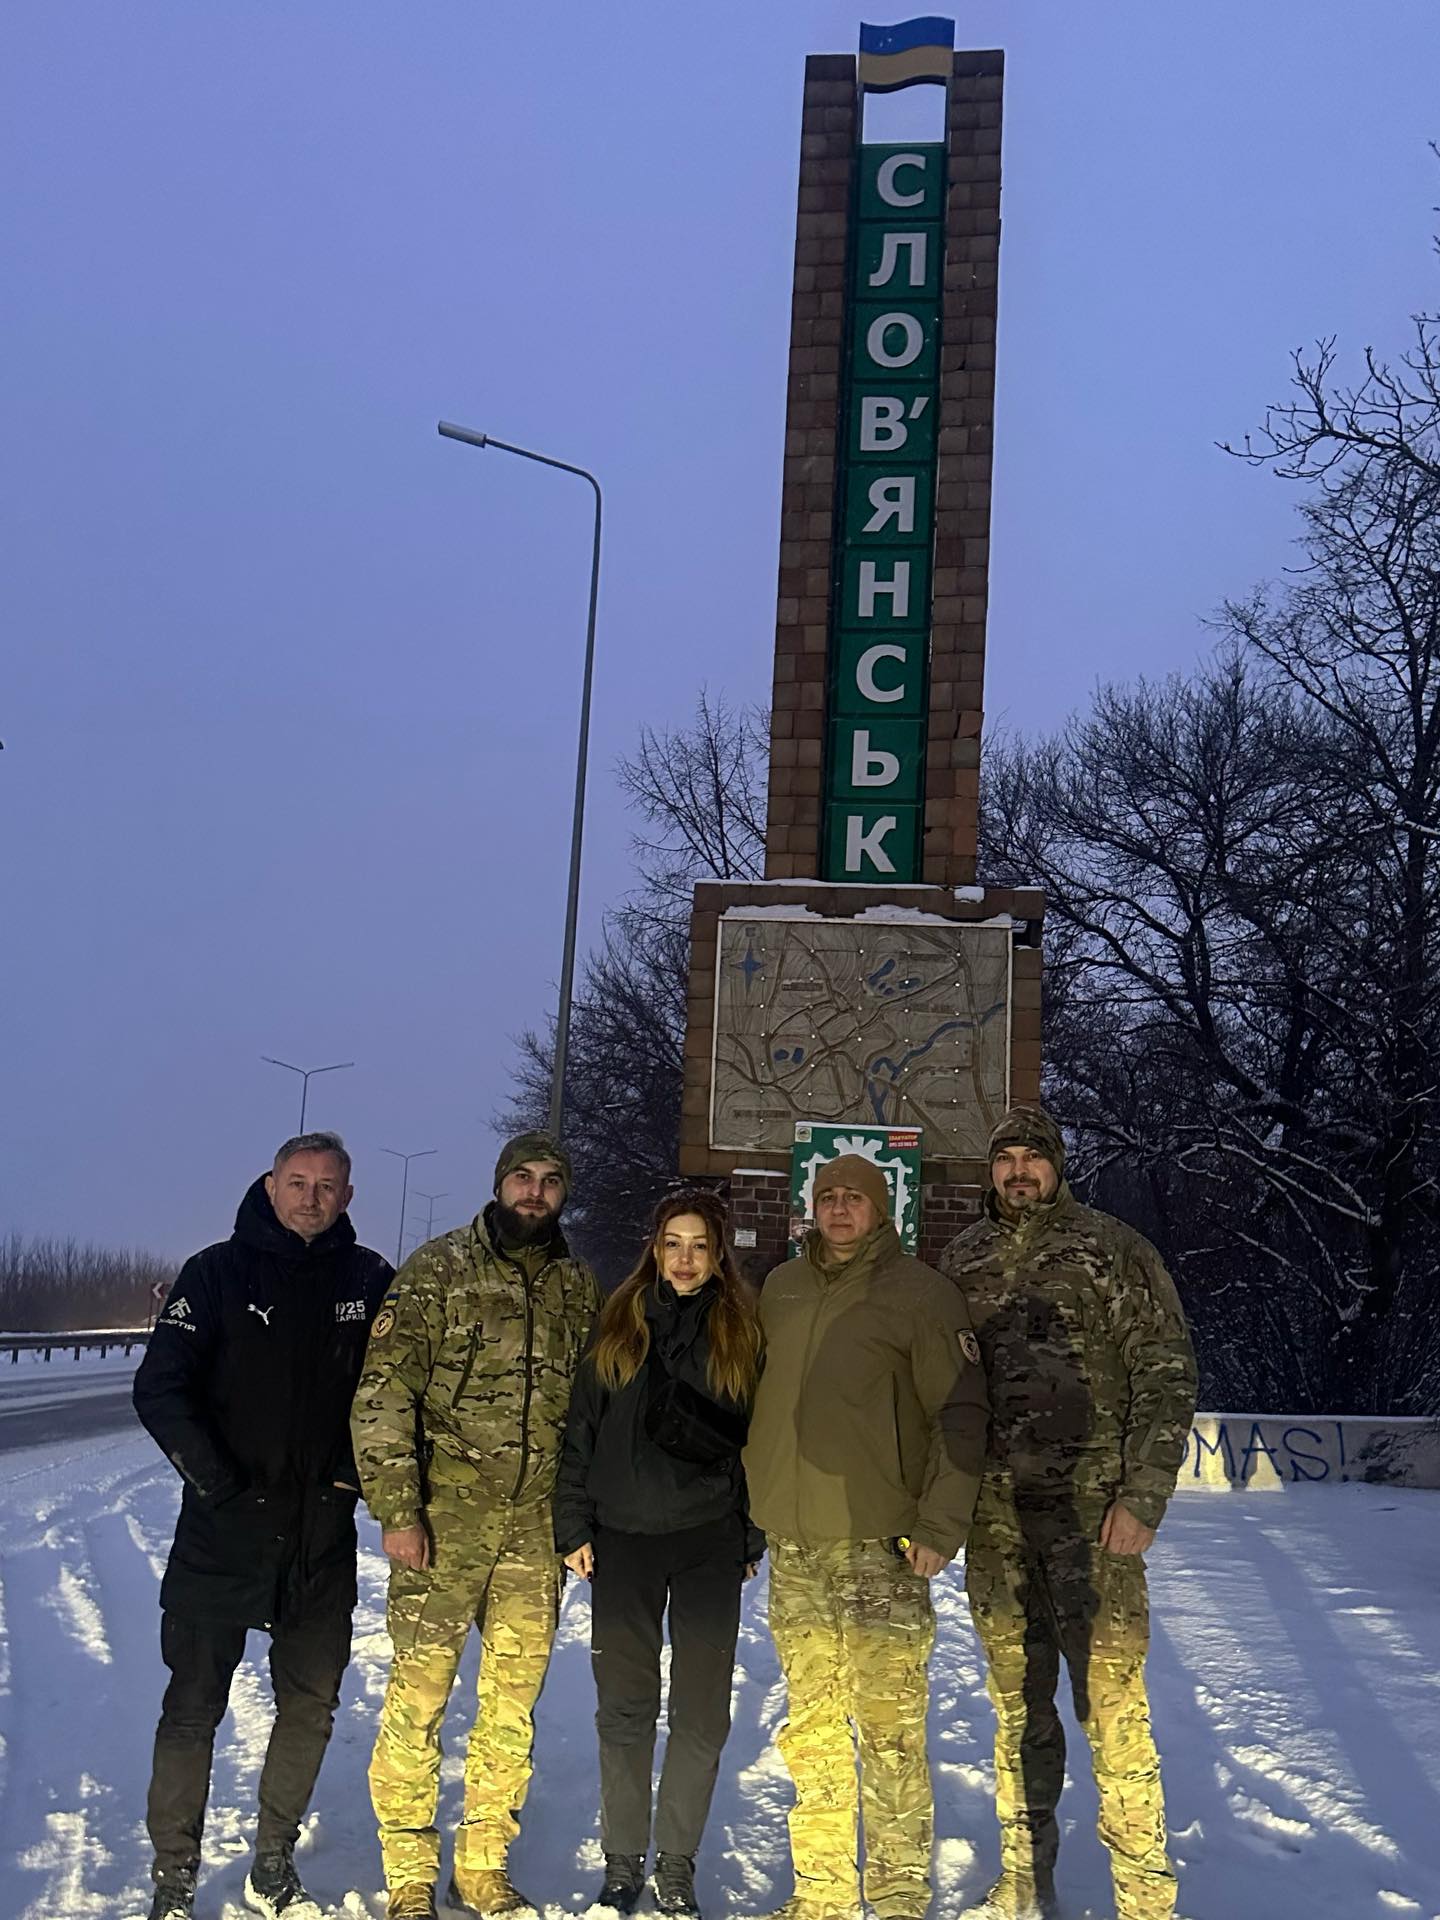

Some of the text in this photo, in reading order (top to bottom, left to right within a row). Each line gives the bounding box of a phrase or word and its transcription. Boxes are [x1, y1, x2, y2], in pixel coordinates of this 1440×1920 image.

[845, 153, 929, 873] СЛОВ'ЯНСЬК
[335, 1299, 366, 1315] 1925
[1181, 1422, 1350, 1483] MAS!
